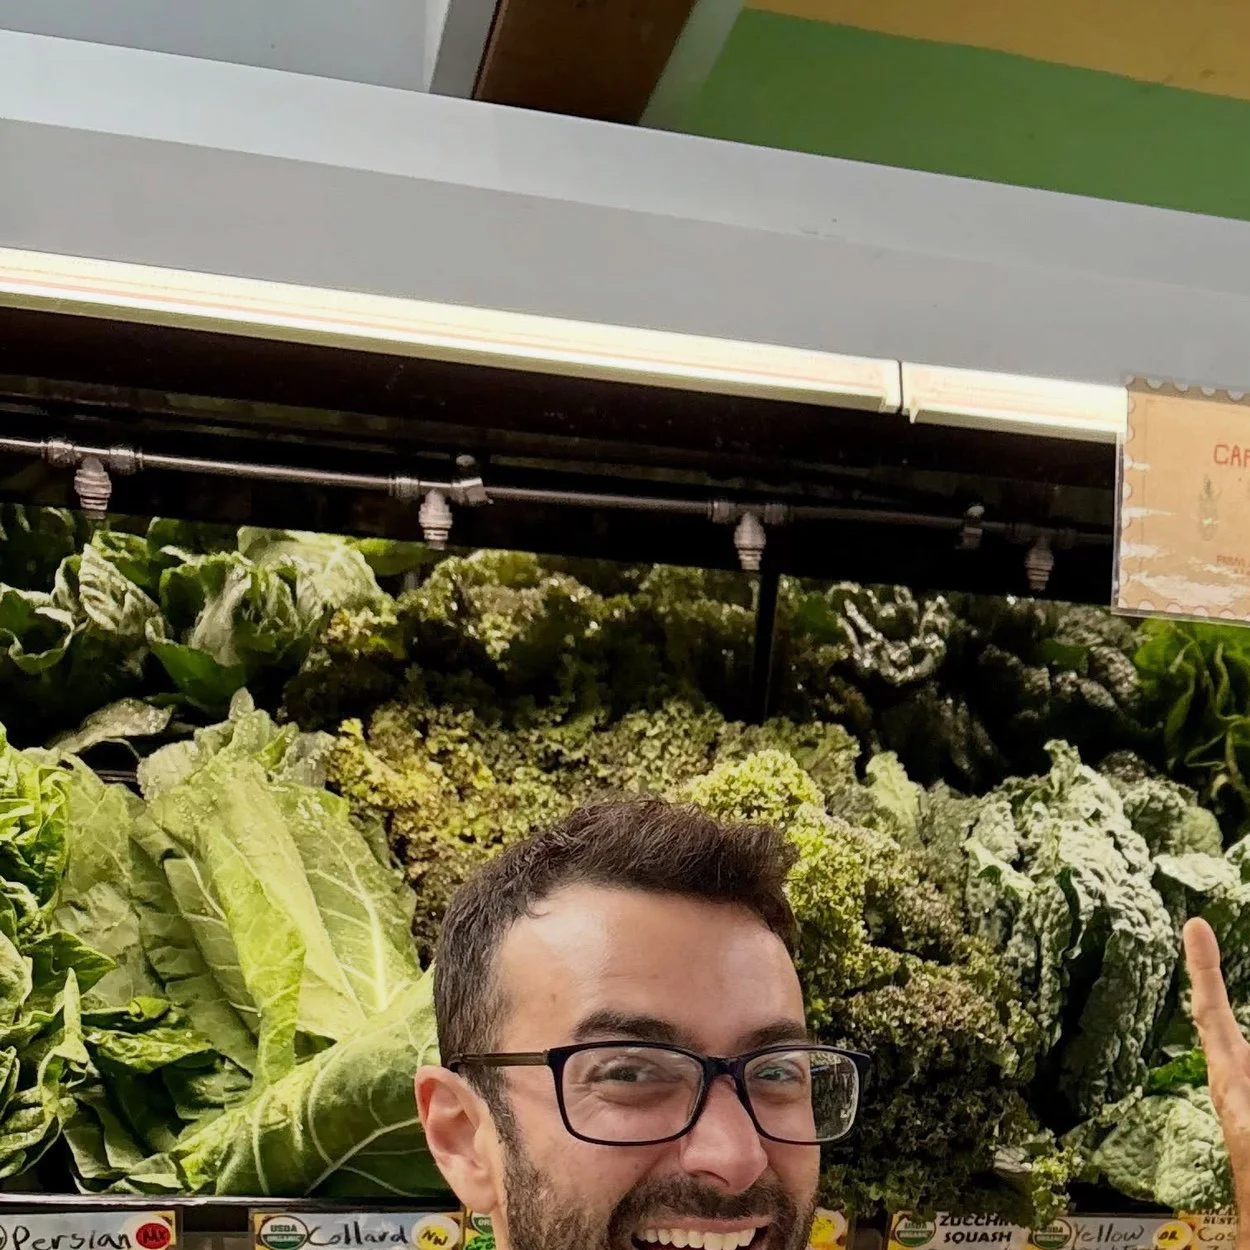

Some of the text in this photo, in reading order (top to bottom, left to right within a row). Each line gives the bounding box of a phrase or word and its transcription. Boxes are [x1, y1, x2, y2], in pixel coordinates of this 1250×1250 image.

[270, 1224, 297, 1233] USDA
[307, 1221, 409, 1246] Collard
[943, 1231, 1012, 1244] SQUASH
[1073, 1223, 1145, 1250] Yellow
